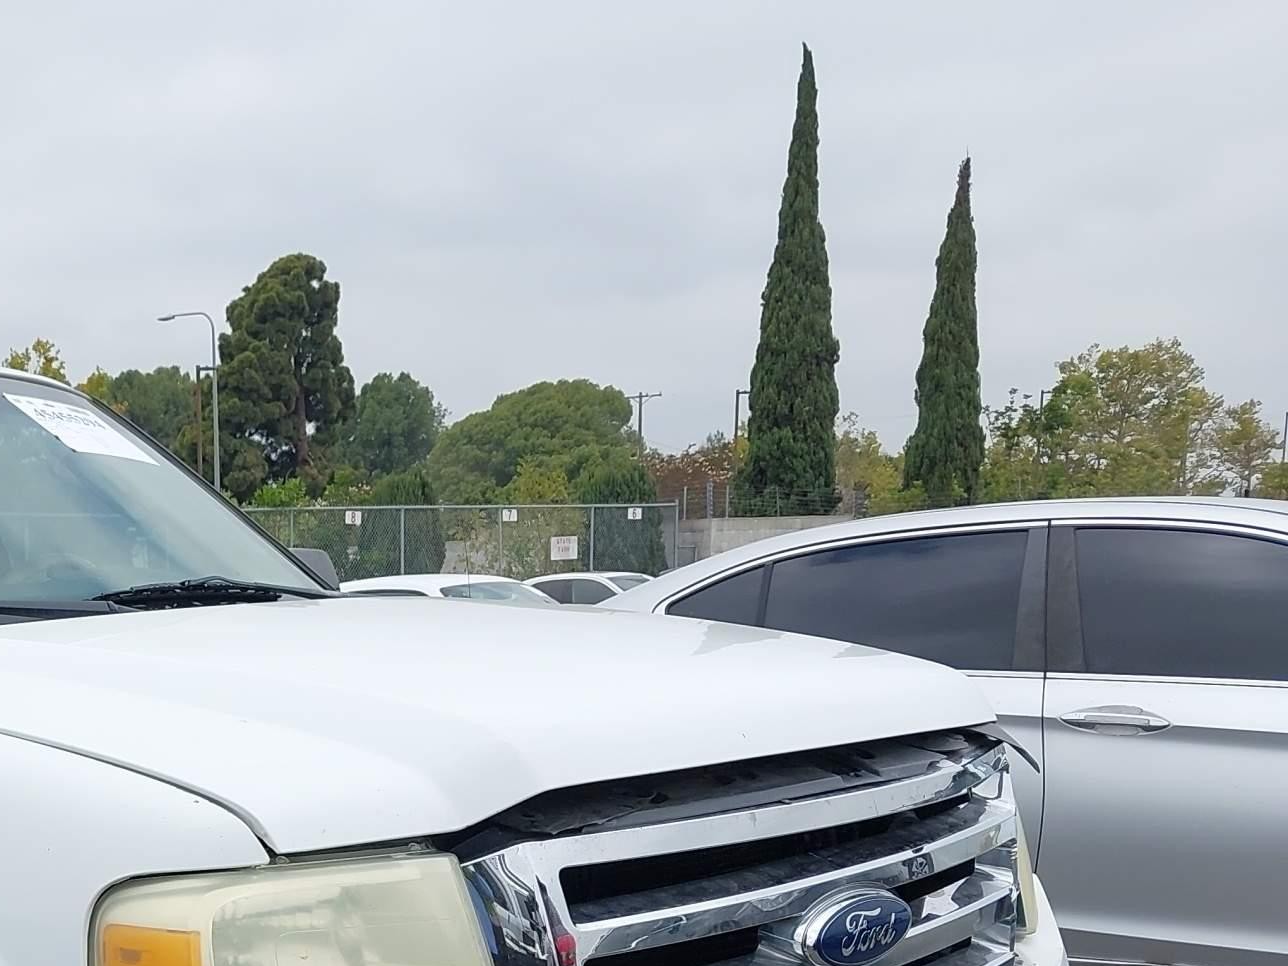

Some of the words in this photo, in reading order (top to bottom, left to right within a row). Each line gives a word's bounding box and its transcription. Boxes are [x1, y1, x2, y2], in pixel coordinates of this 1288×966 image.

[350, 511, 357, 524] 8
[507, 509, 513, 521] 7
[632, 508, 638, 519] 6
[841, 906, 897, 957] Ford
